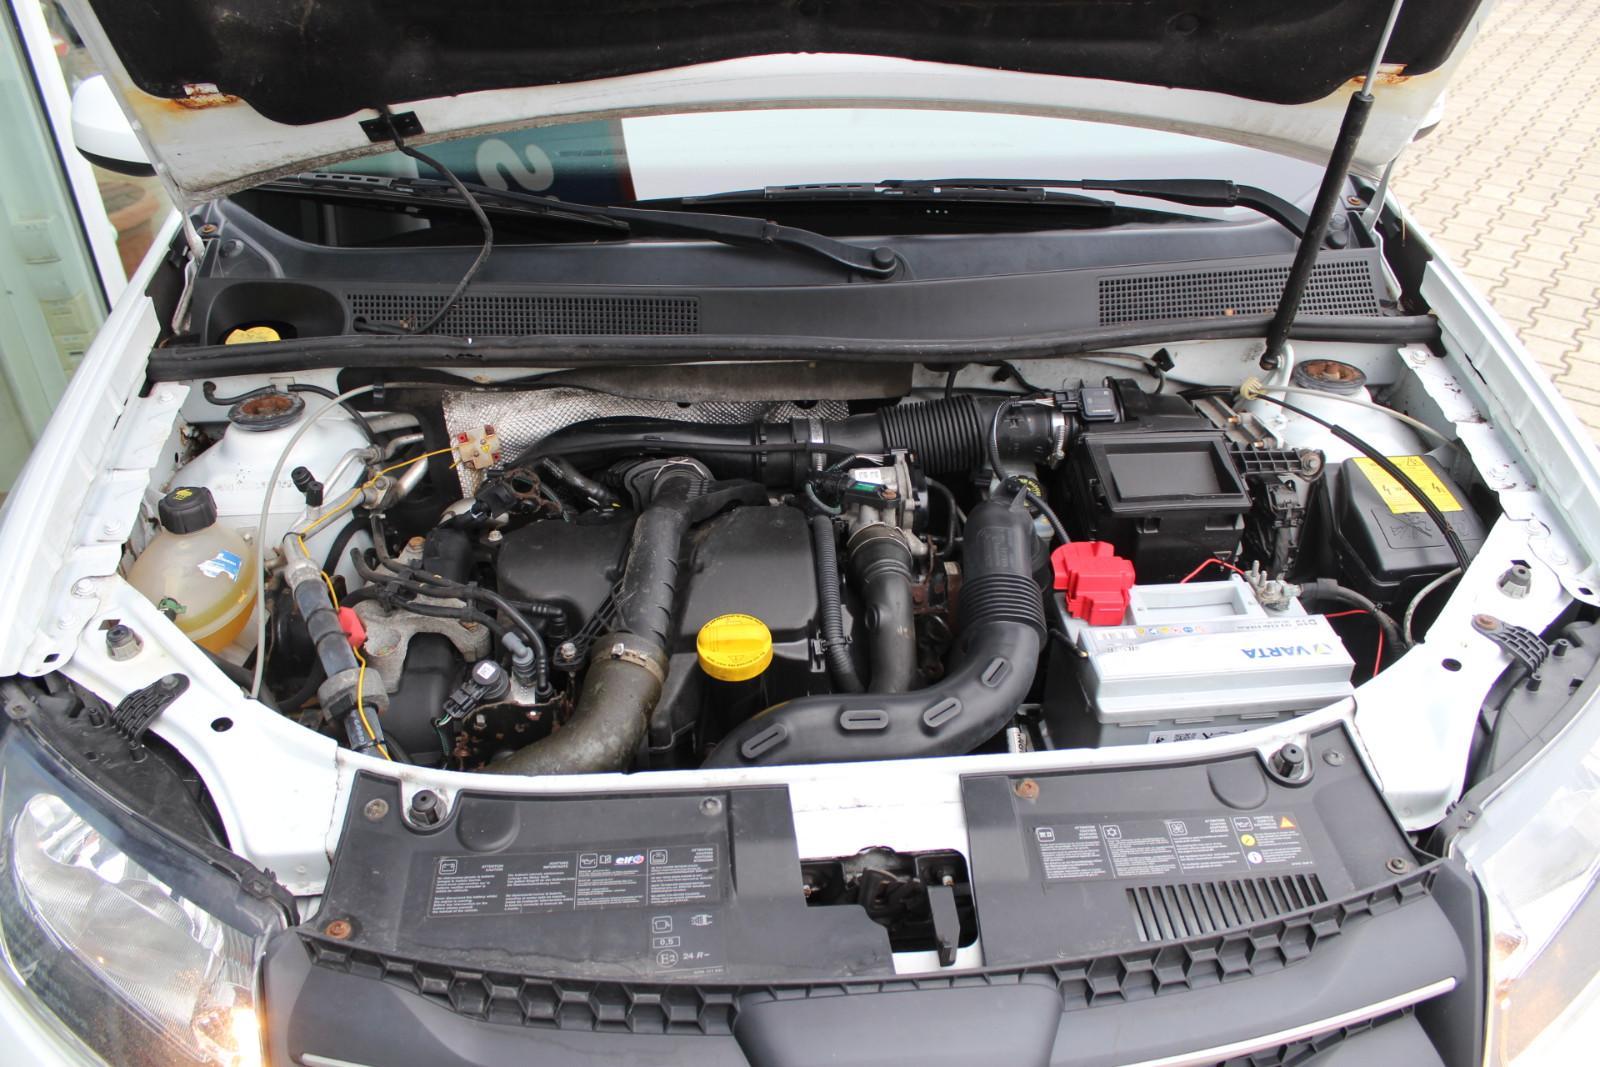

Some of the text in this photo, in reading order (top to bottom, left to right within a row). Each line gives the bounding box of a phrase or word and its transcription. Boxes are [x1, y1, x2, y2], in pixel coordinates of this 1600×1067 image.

[1240, 644, 1311, 660] VARTA
[660, 953, 676, 965] E2
[682, 952, 694, 960] 24
